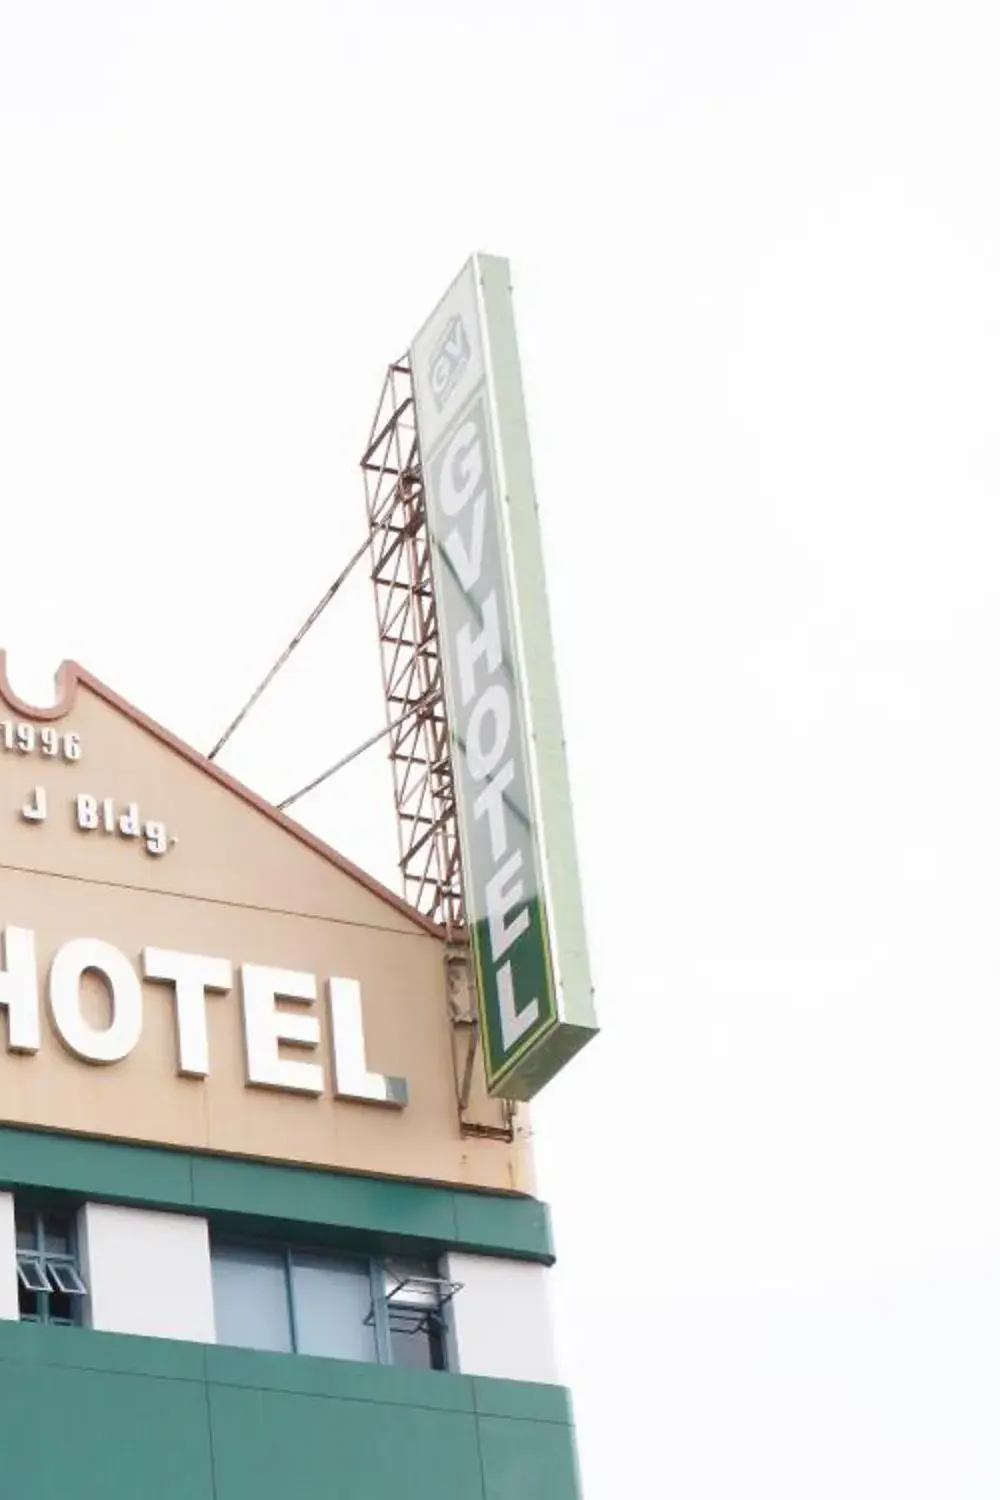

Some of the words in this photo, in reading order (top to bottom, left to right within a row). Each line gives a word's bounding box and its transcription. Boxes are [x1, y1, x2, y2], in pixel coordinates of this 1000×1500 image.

[440, 420, 488, 592] GV
[0, 719, 83, 761] 1996
[21, 784, 47, 821] J
[456, 602, 539, 1053] HOTEL
